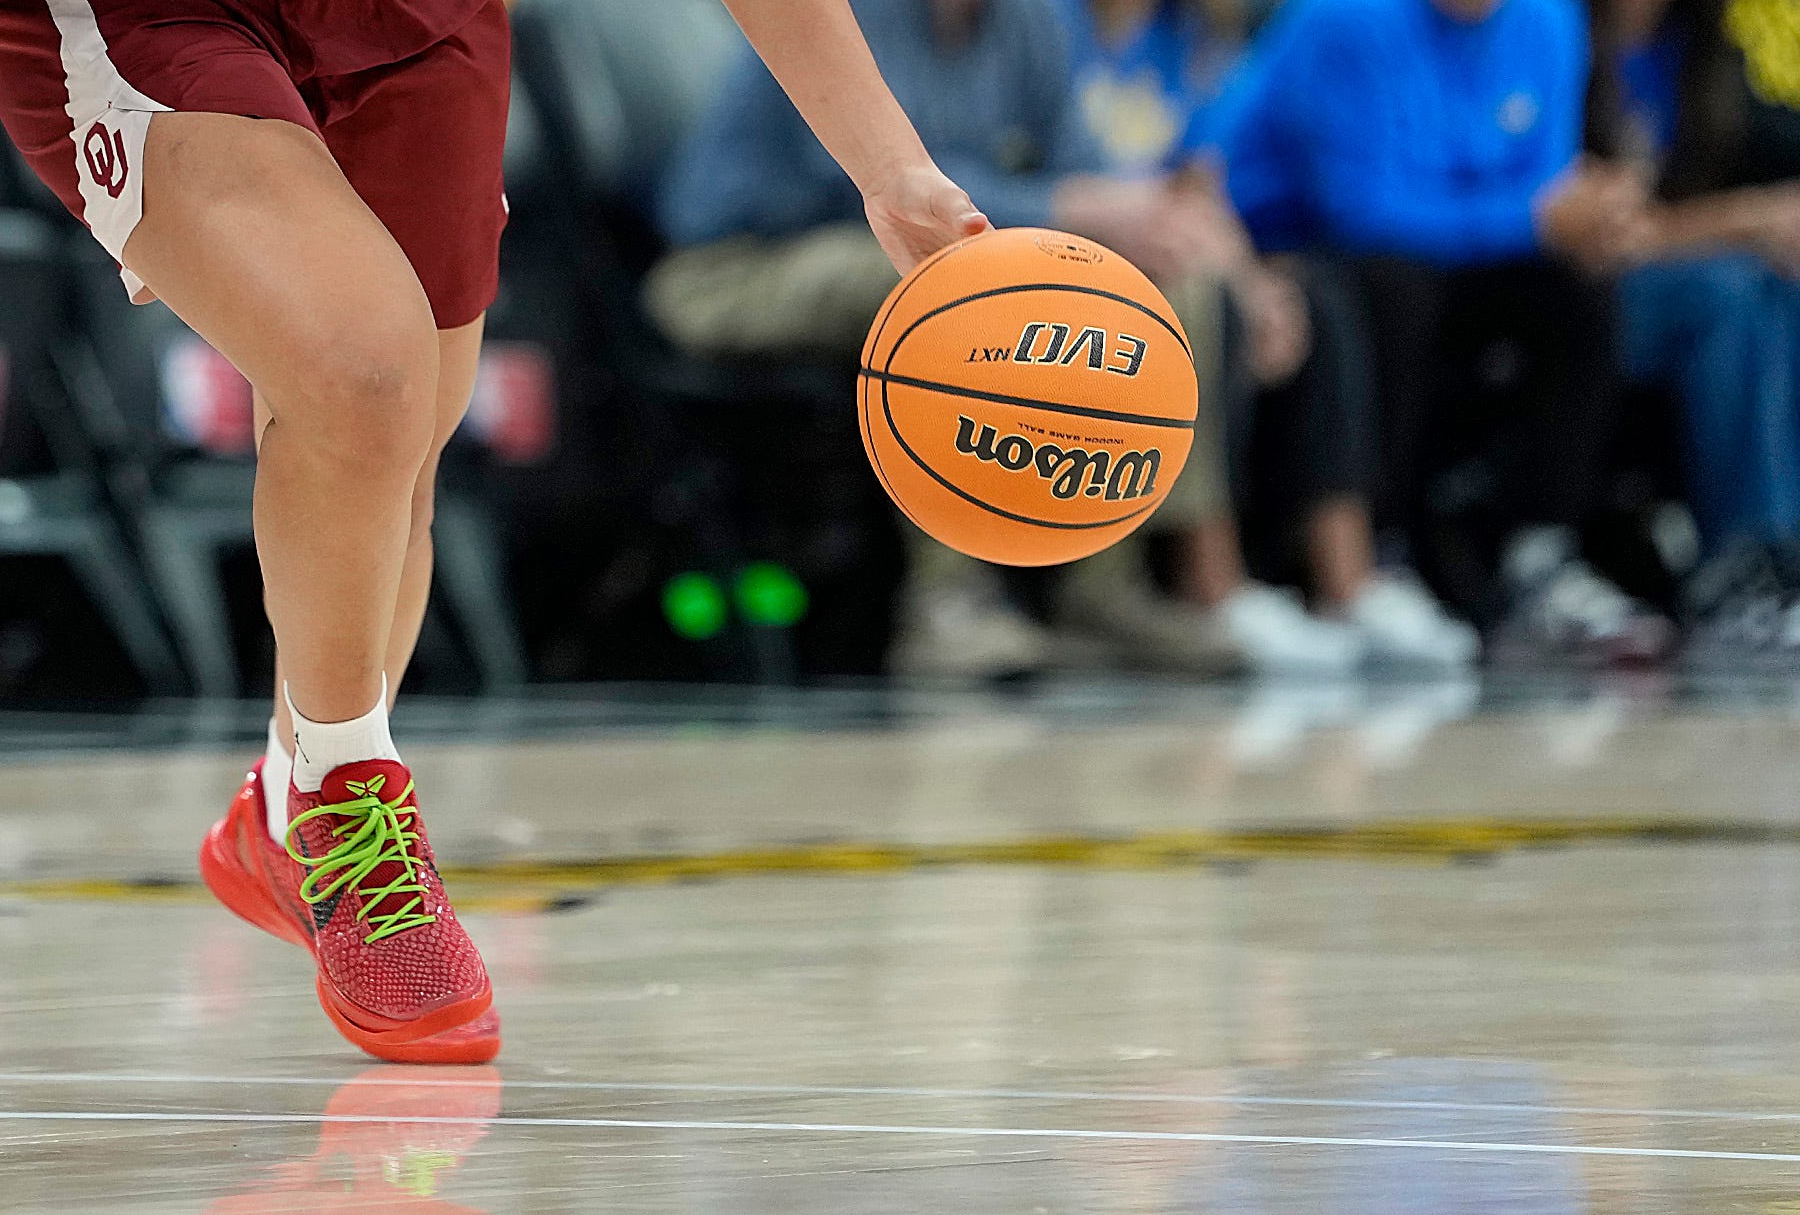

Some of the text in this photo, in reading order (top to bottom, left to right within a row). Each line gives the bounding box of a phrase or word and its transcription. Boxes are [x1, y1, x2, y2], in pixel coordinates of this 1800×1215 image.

[84, 121, 129, 199] OU
[963, 321, 1147, 378] EVO NXT
[954, 413, 1162, 503] Wilson
[1017, 422, 1045, 435] BALL
